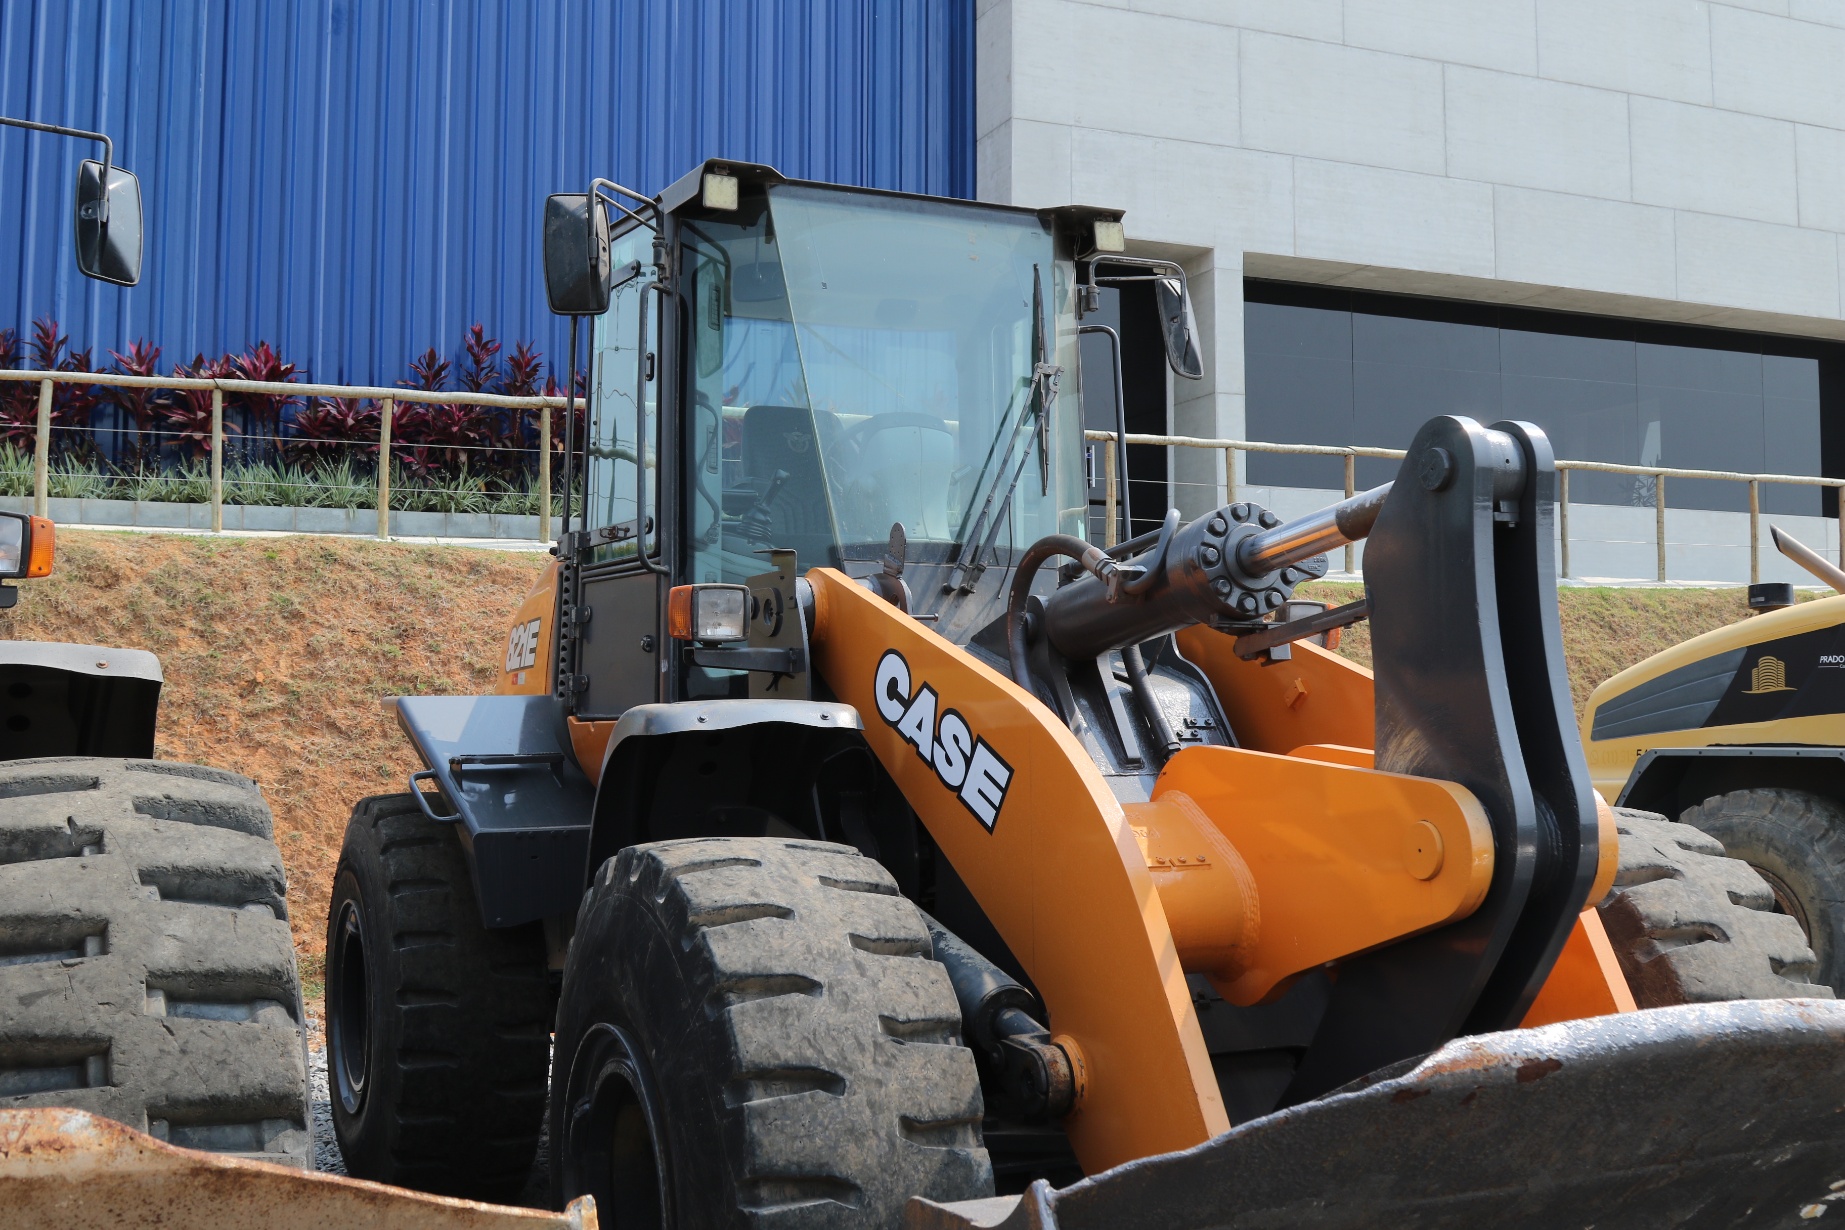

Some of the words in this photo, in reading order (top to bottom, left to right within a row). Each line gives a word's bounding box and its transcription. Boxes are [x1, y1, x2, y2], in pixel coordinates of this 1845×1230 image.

[506, 617, 541, 673] 821E
[1819, 655, 1845, 663] PRADO
[874, 648, 1015, 836] CASE
